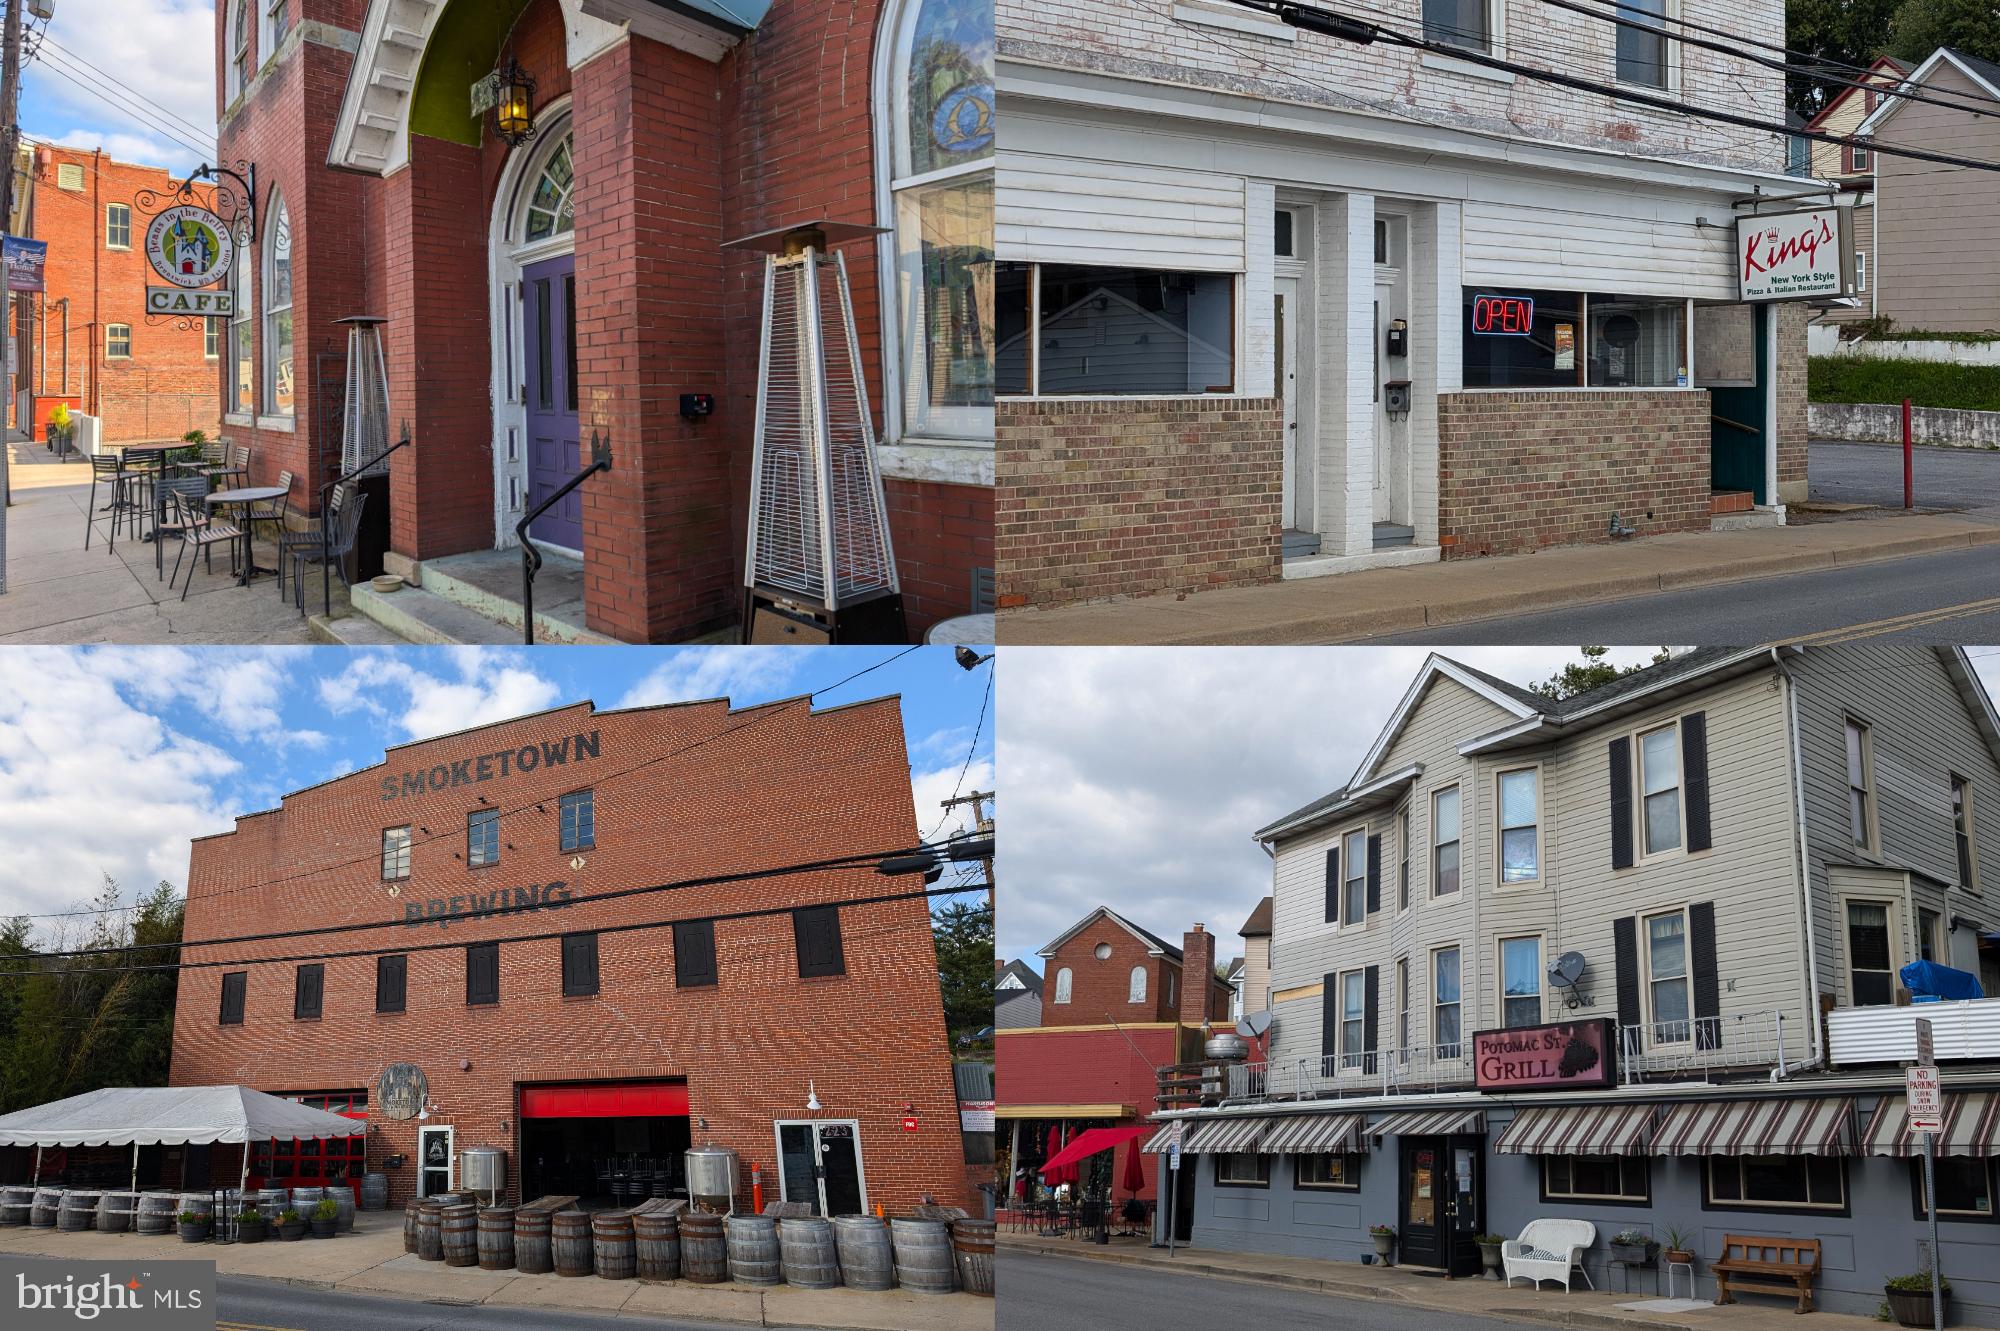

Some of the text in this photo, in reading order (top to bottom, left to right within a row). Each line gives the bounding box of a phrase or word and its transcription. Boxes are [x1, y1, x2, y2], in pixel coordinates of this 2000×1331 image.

[149, 208, 228, 253] Beans in the Belfry
[1745, 214, 1835, 282] King's
[1771, 272, 1835, 285] New York Style
[1775, 286, 1796, 294] Italian
[1798, 283, 1835, 292] Restaurant
[150, 292, 231, 311] CAFE
[1475, 299, 1531, 333] OPEN
[380, 730, 602, 801] SMOKETOWN
[404, 881, 572, 928] BREWING
[1481, 1056, 1556, 1081] GRILL
[1916, 1070, 1928, 1079] NO
[1909, 1081, 1937, 1090] PARKING
